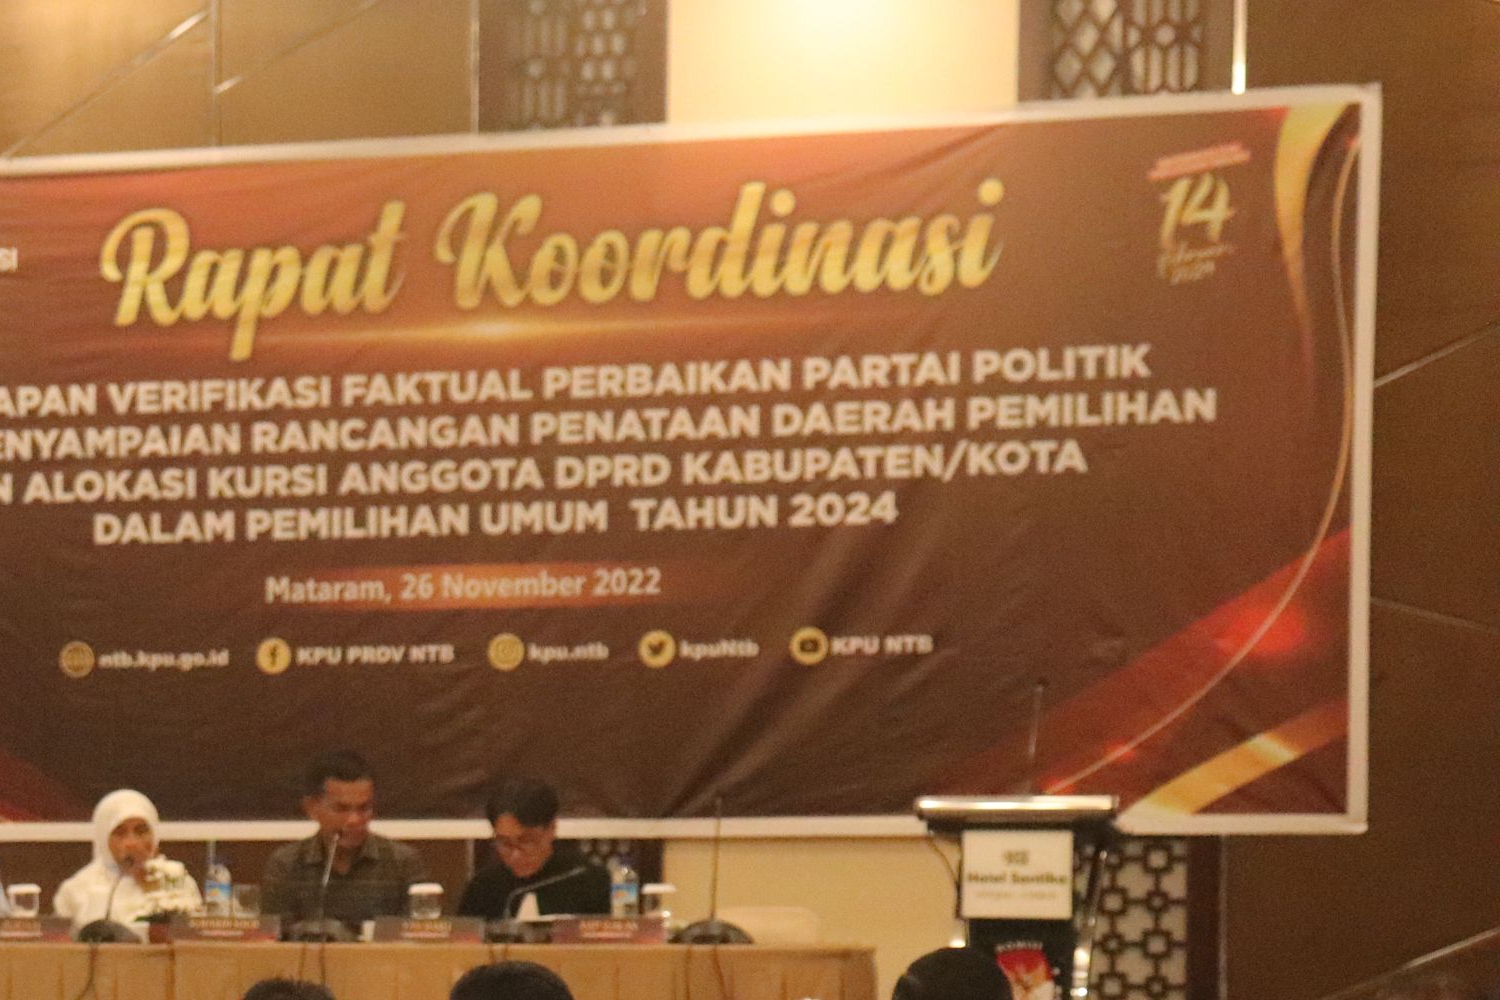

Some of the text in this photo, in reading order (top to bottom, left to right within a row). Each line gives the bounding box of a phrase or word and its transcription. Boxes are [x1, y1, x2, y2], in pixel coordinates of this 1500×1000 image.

[1159, 171, 1235, 250] 14
[100, 177, 1004, 360] Rapat Koordinasi
[106, 375, 332, 415] VERIFIKASI
[342, 368, 534, 407] FAKTUAL
[542, 358, 792, 399] PERBAIKAN
[802, 351, 961, 390] PARTAI
[972, 343, 1151, 384] POLITIK
[251, 413, 520, 453] RANCANGAN
[530, 403, 761, 444] PENATAAN
[772, 396, 955, 437] DAERAH
[966, 388, 1217, 430] PEMILIHAN
[23, 467, 197, 504] ALOKASI
[207, 464, 328, 498] KURSI
[338, 457, 544, 495] ANGGOTA
[555, 453, 672, 489] DPRD
[682, 437, 1088, 485] KABUPATEN/KOTA
[93, 490, 898, 545] DALAM PEMILIHAN UMUM TAHUN 2024
[265, 567, 661, 604] Mataram, 26 November 2022
[97, 649, 230, 671] ntb.kpu.go.id
[296, 643, 455, 665] KPU PROV NTB
[527, 641, 609, 664] kpu.ntb
[830, 634, 933, 655] KPU NTB
